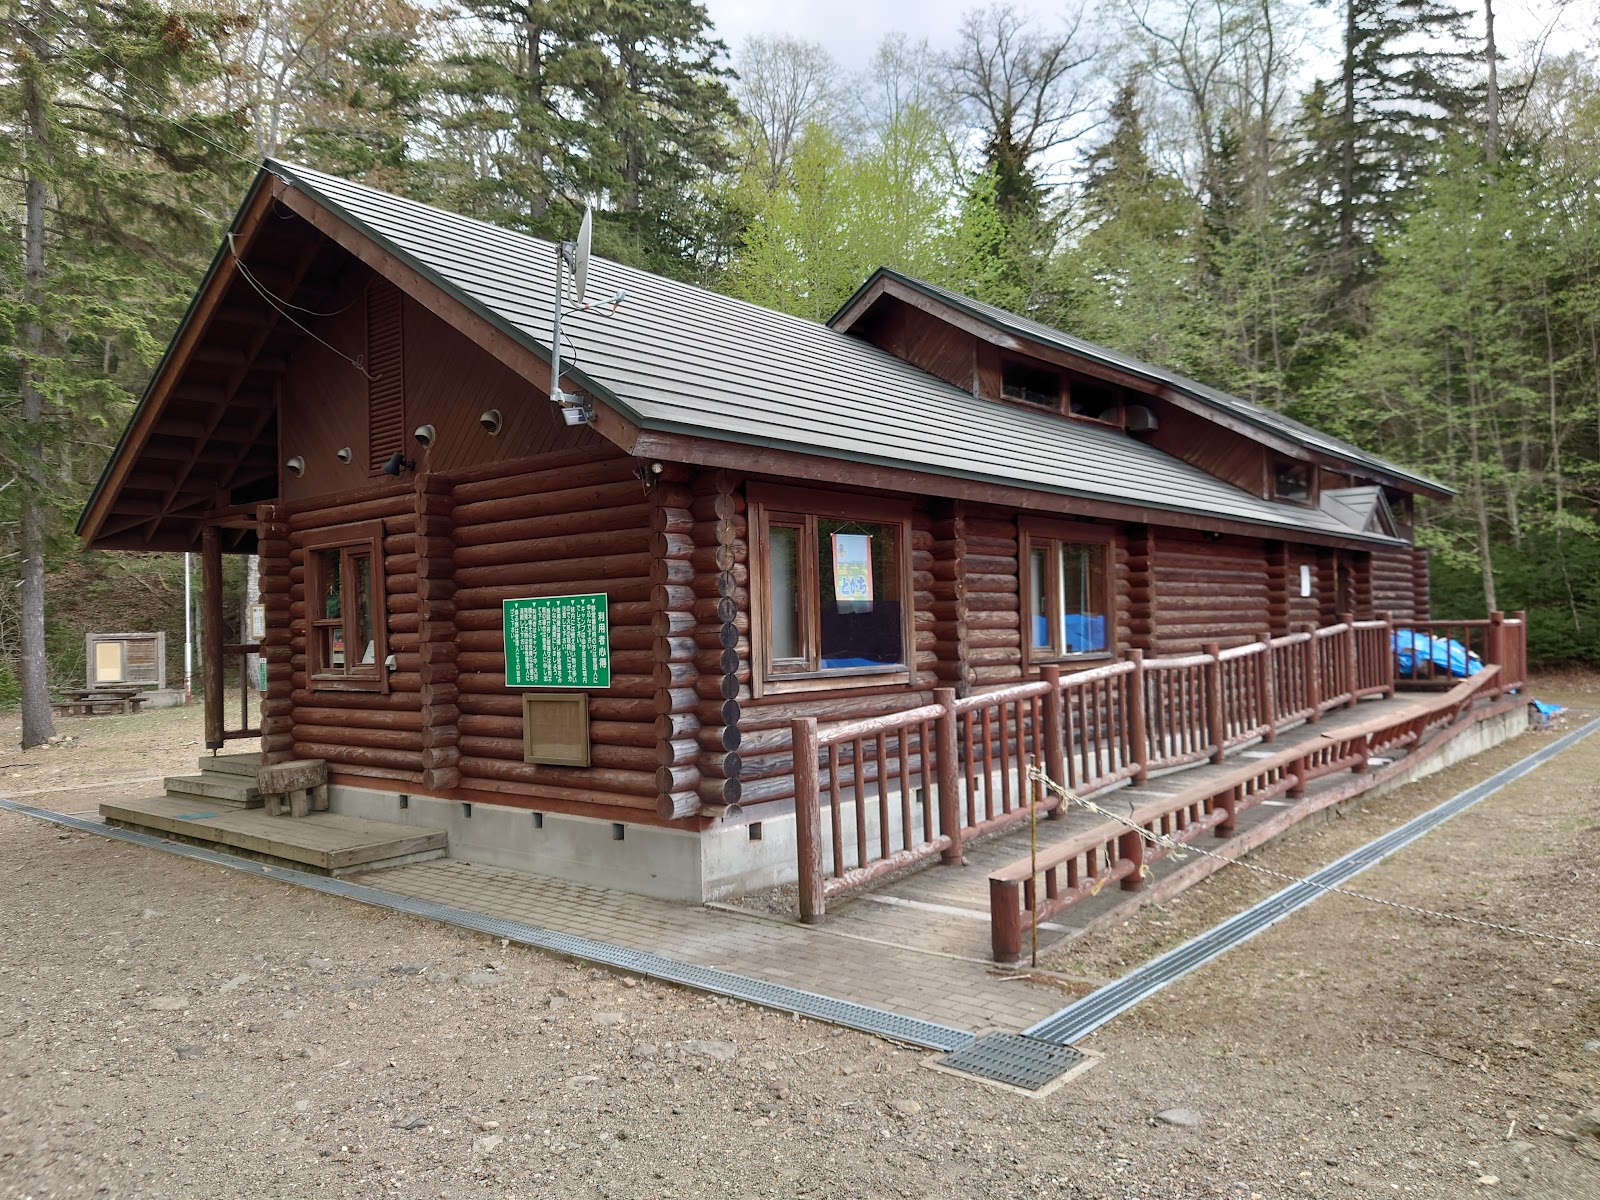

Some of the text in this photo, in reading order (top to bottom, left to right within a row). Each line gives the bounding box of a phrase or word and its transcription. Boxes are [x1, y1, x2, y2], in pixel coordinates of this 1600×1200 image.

[841, 576, 867, 595] とかち
[598, 612, 607, 668] 利用者心得
